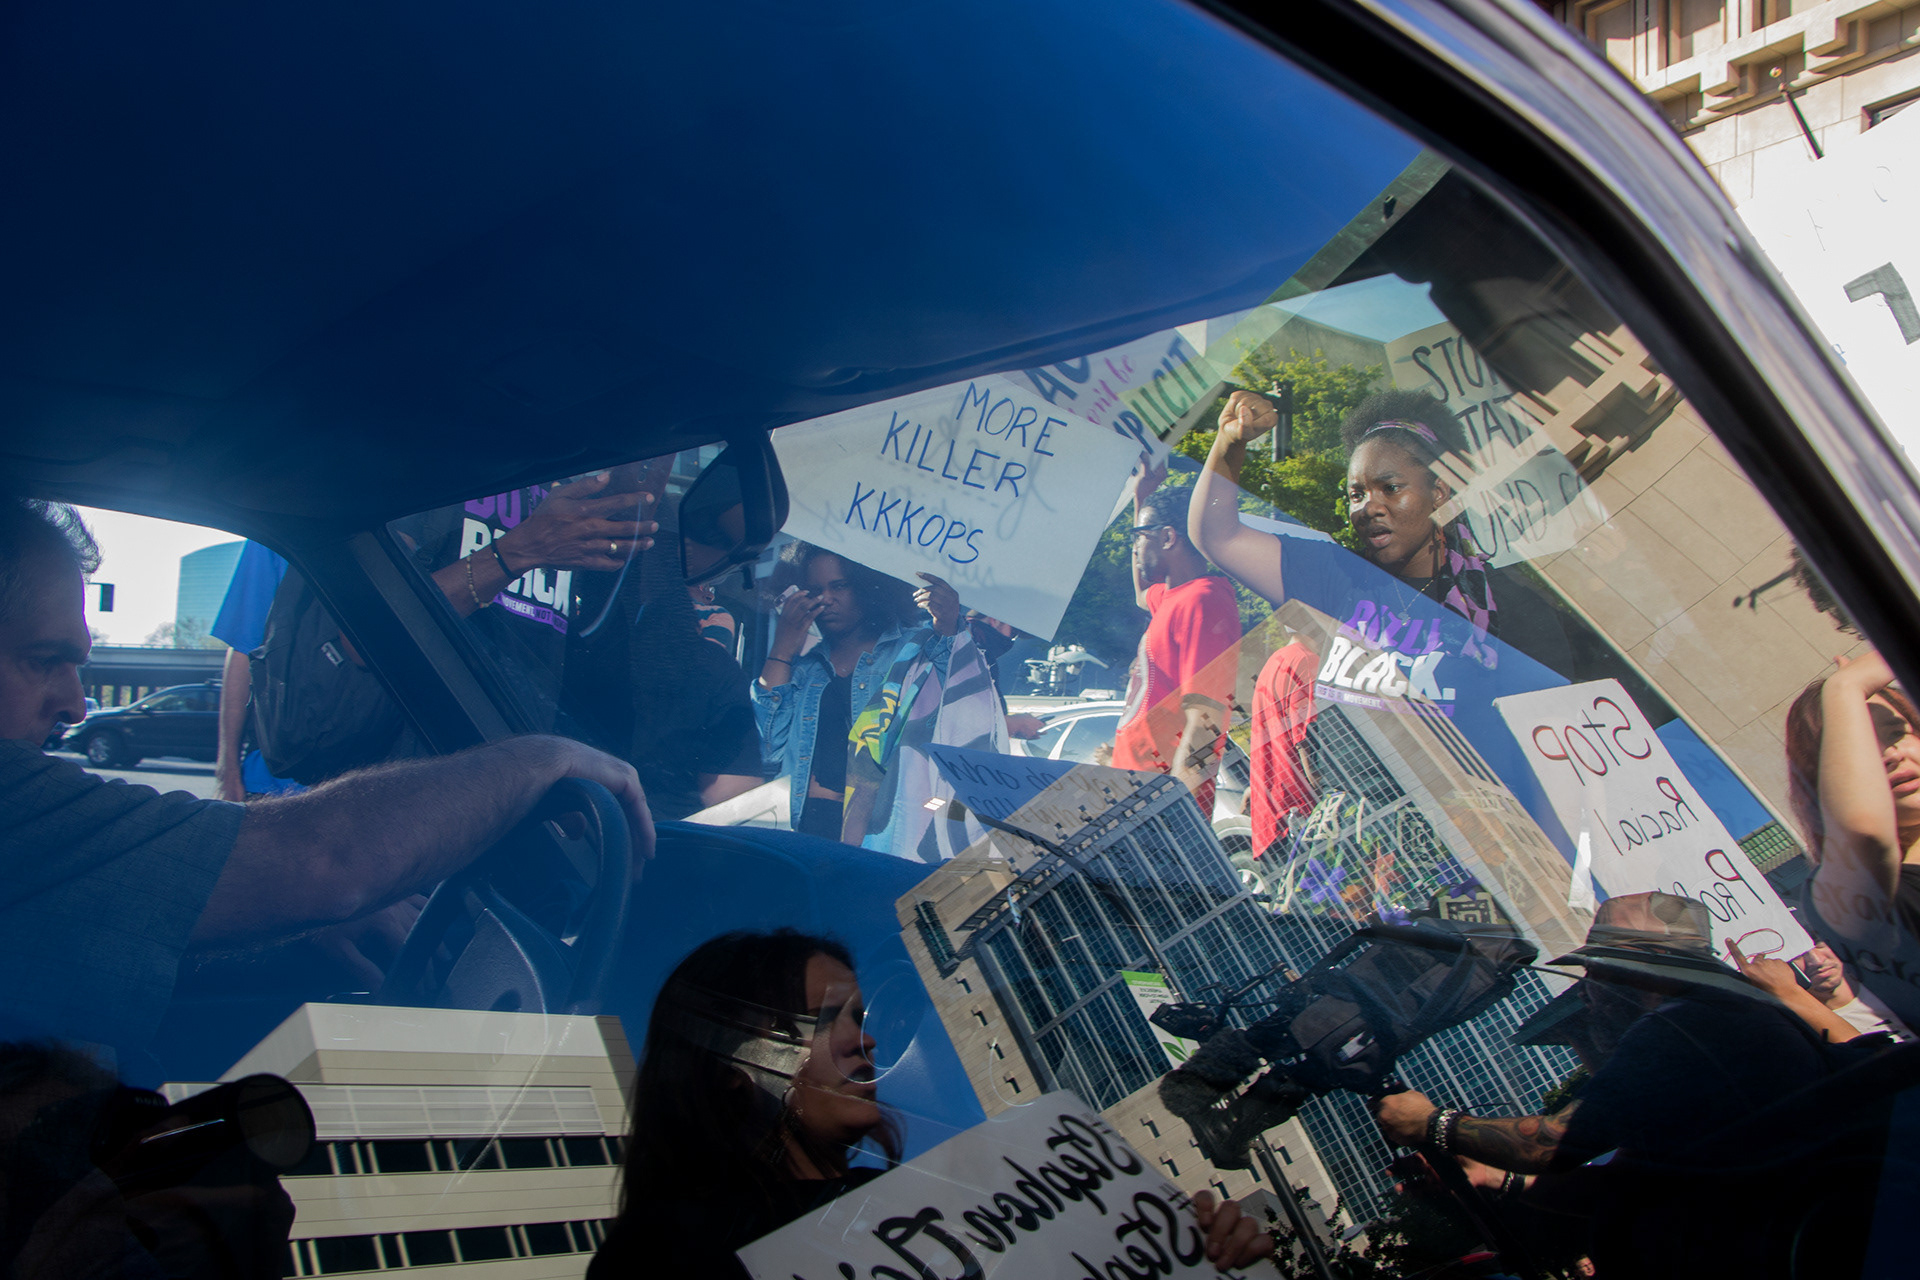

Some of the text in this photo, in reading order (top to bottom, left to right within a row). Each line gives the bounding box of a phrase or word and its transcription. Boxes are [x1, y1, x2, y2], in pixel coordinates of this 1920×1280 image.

[1411, 328, 1500, 403] STO
[880, 411, 1027, 498] KILLER
[956, 381, 1068, 457] MORE
[844, 481, 985, 564] KKKOPS
[933, 751, 1020, 791] Who
